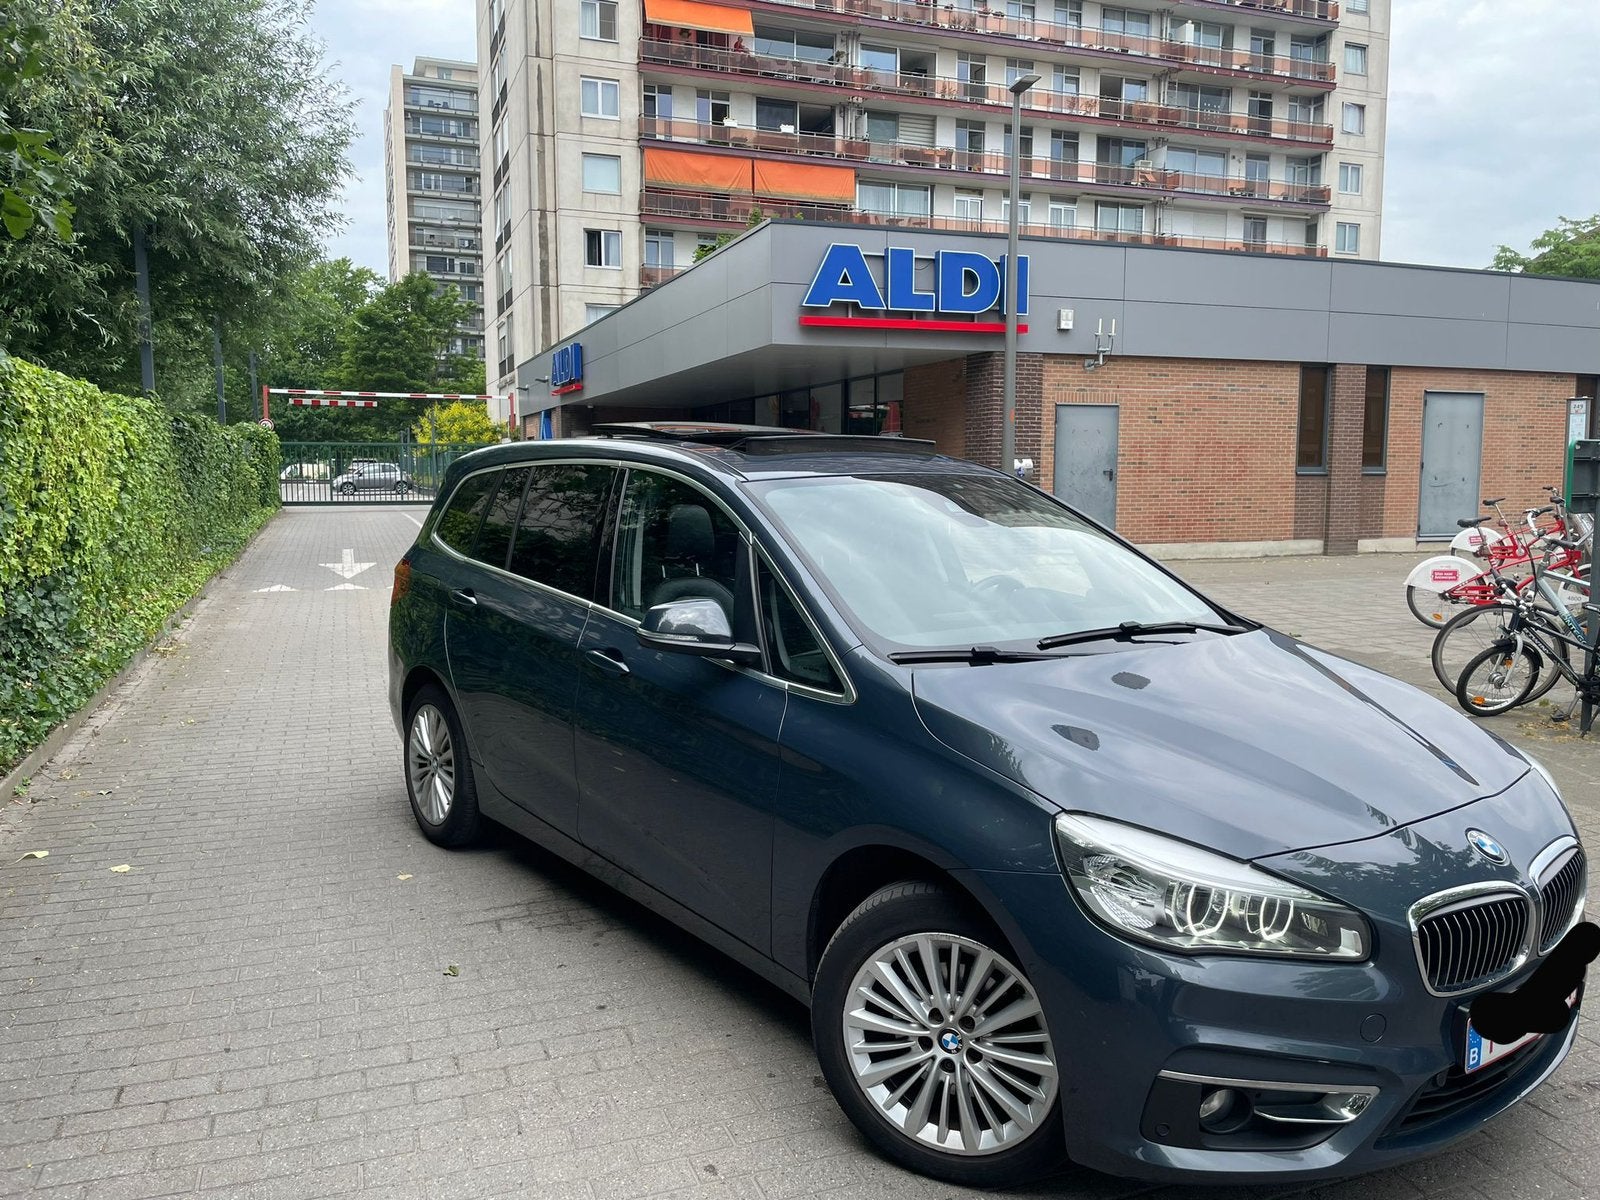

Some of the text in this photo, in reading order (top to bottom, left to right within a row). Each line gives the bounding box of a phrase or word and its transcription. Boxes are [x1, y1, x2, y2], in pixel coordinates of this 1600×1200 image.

[802, 243, 1030, 316] ALDI
[551, 342, 583, 387] ALDI
[1469, 1047, 1479, 1065] B
